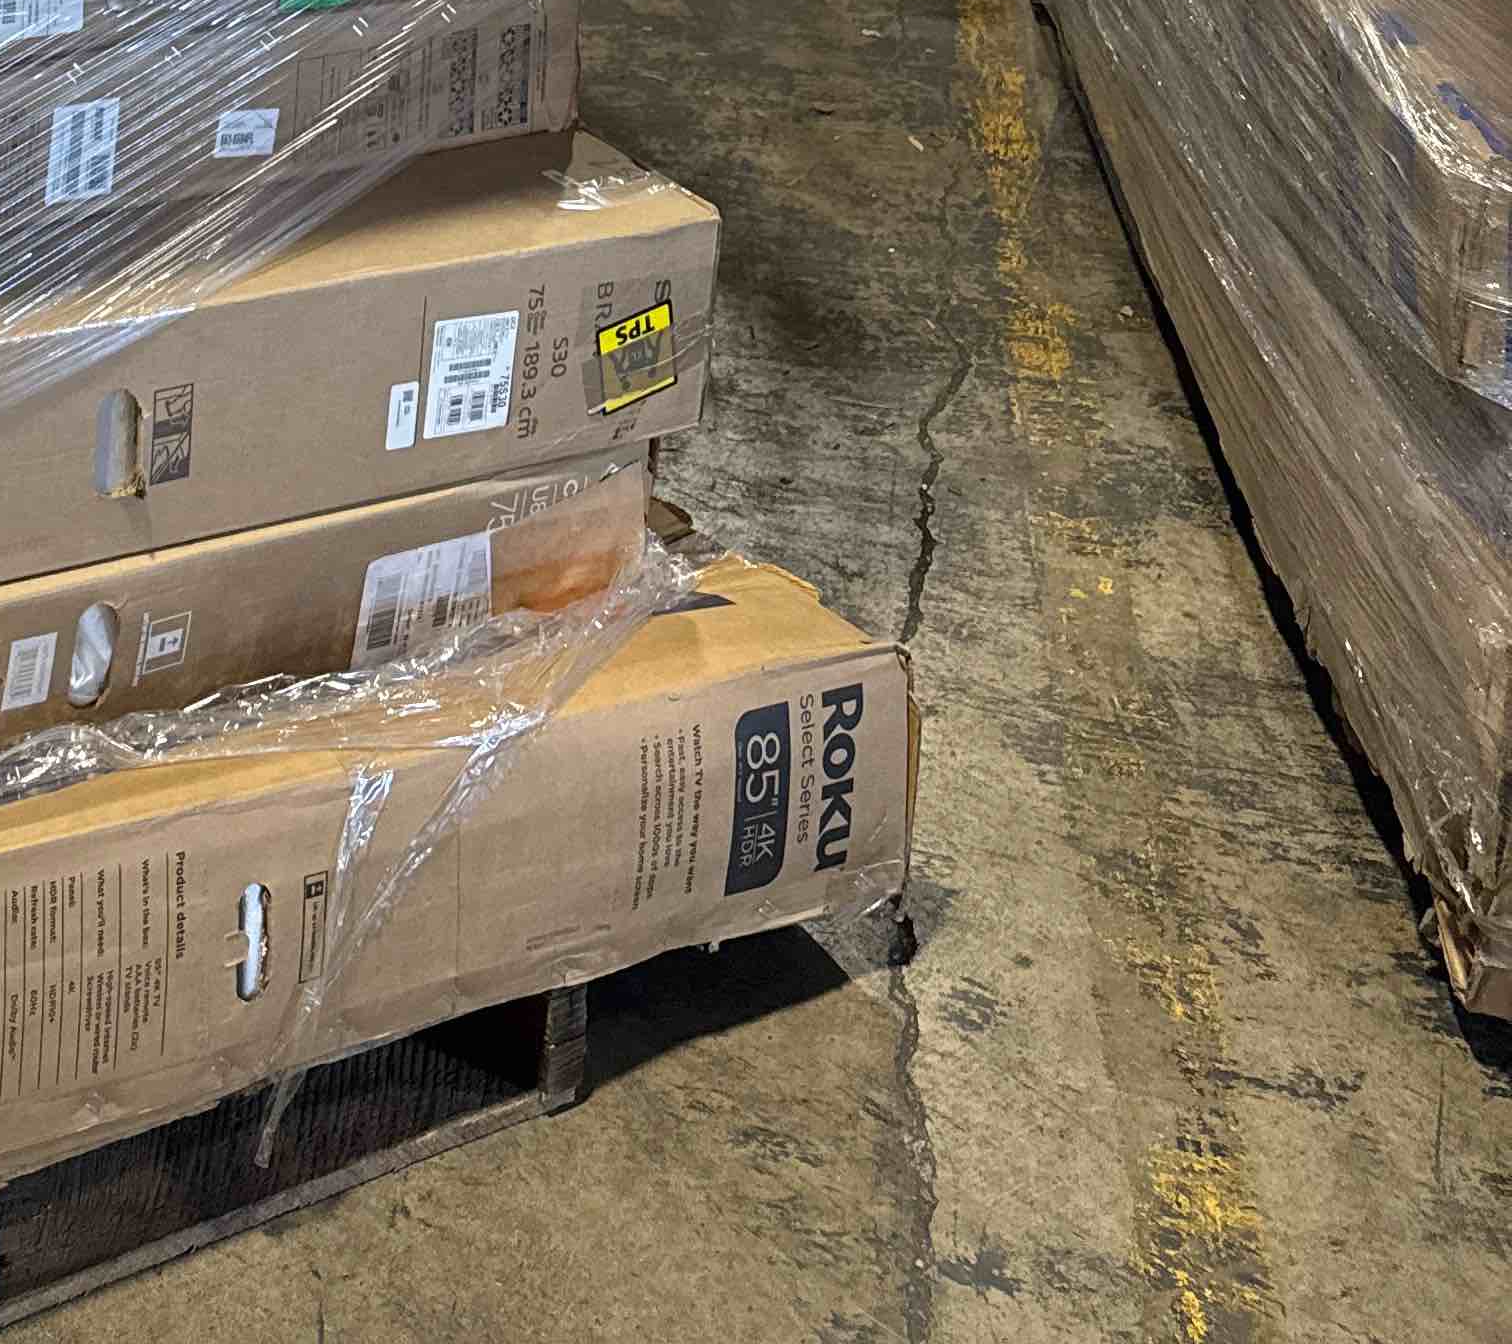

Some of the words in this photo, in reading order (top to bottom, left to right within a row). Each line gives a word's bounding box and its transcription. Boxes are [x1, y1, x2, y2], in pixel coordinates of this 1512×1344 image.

[527, 285, 545, 310] 75
[613, 312, 656, 345] TPS
[520, 339, 539, 400] 189.3
[550, 336, 568, 377] S30
[518, 405, 537, 439] cm
[798, 693, 815, 765] Select
[795, 773, 812, 843] Series
[738, 823, 755, 868] HDR
[756, 823, 775, 862] 4K
[68, 877, 76, 907] Panel:
[141, 860, 150, 894] What's
[174, 852, 186, 908] Product
[11, 891, 19, 923] Audio:
[30, 886, 38, 924] Refresh
[95, 900, 105, 926] you'll
[141, 907, 149, 924] the
[49, 907, 57, 944] format:
[96, 929, 104, 957] need:
[175, 913, 186, 959] details
[125, 967, 132, 979] TV
[144, 961, 152, 983] Voice
[8, 995, 19, 1023] Dolby
[84, 976, 93, 1032] Screwdriver
[104, 971, 114, 1025] High-speed
[123, 982, 131, 1013] stands
[132, 988, 141, 1029] batteries
